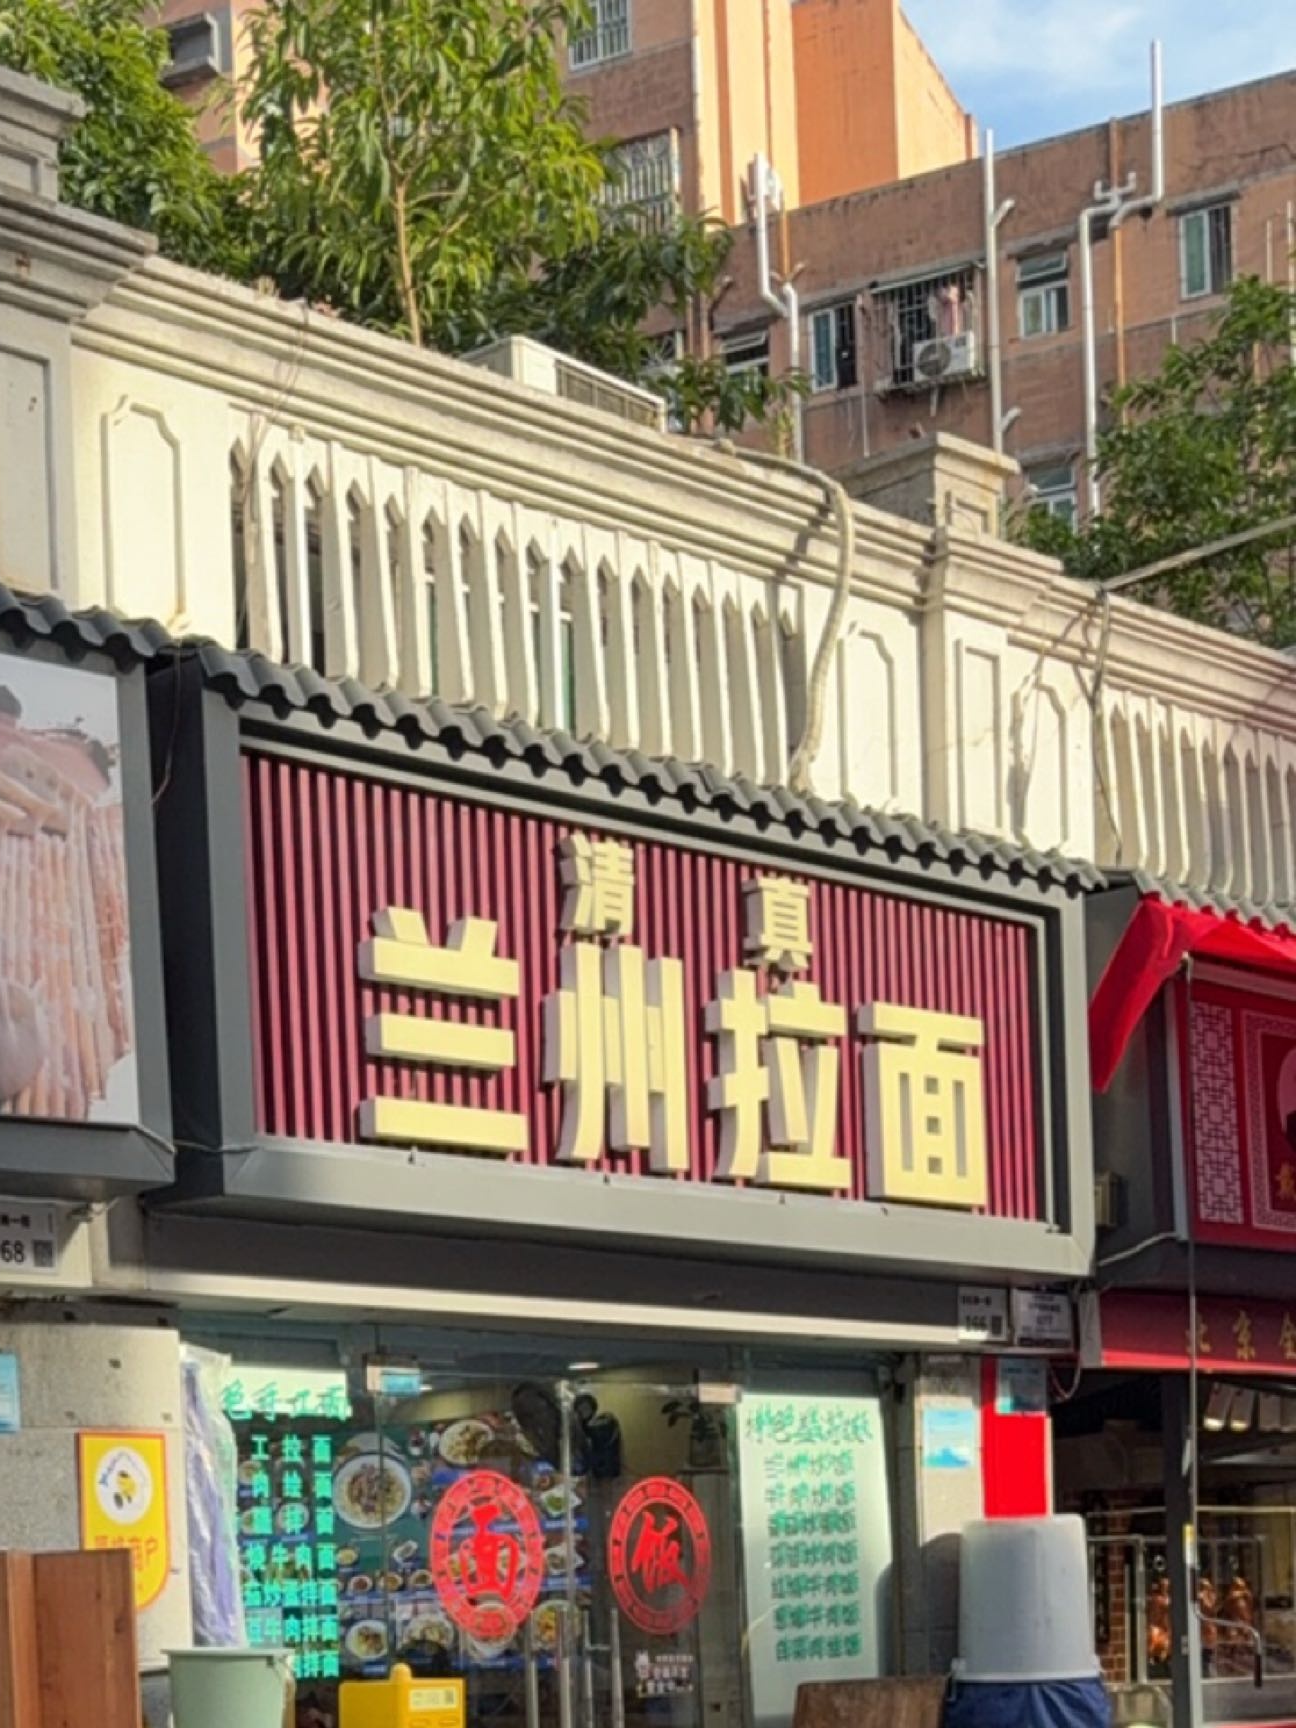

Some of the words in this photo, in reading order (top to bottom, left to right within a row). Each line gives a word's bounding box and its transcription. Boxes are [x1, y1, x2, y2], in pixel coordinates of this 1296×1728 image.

[559, 831, 813, 971] 清真
[359, 907, 988, 1207] 兰州拉面
